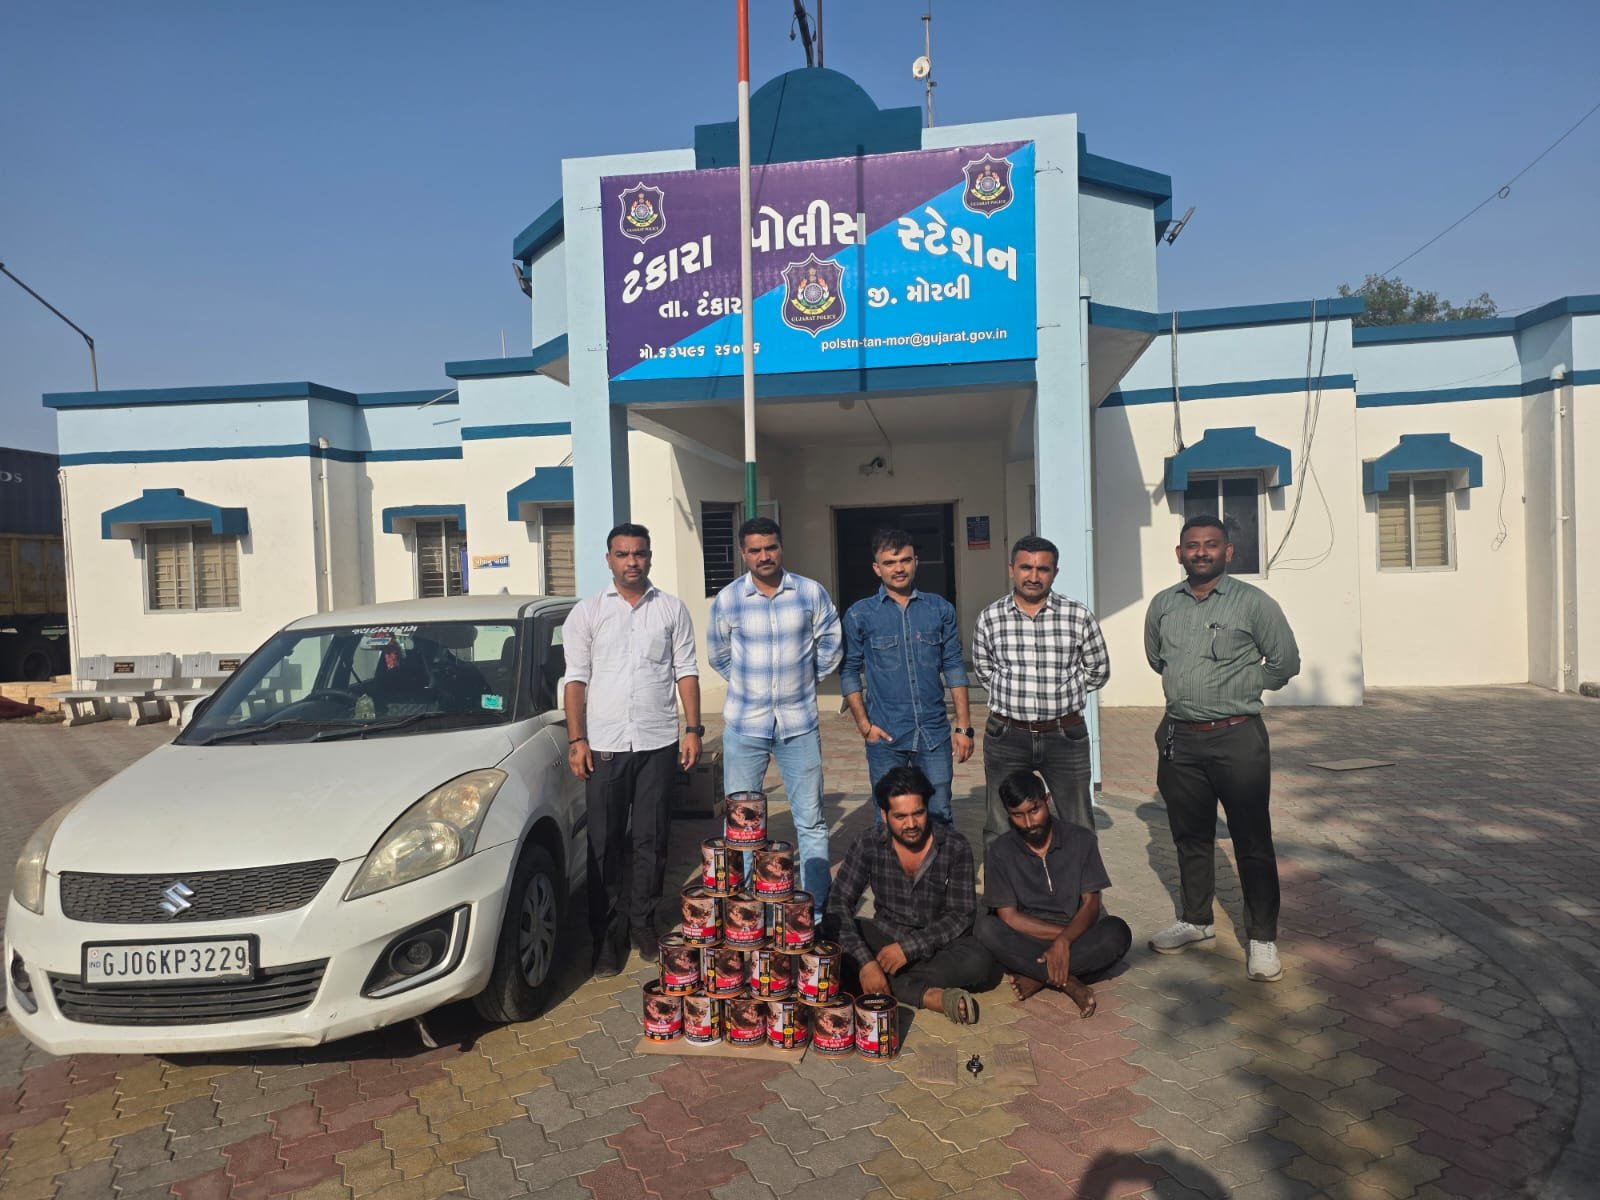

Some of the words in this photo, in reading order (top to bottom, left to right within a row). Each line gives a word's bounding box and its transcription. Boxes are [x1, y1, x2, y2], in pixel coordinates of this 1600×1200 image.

[622, 234, 713, 304] ટંકારા
[751, 199, 867, 253] પોલીસ
[897, 206, 1017, 282] સ્ટેશન
[658, 300, 689, 318] તા.
[696, 291, 743, 317] ટંકાર
[867, 286, 898, 308] જી.
[906, 273, 970, 304] મોરબી
[714, 342, 761, 357] ૨૬૦૬
[820, 328, 1008, 352] polstn-tan-mor@gujarat.gov.in
[103, 946, 246, 976] GJ06KP3229
